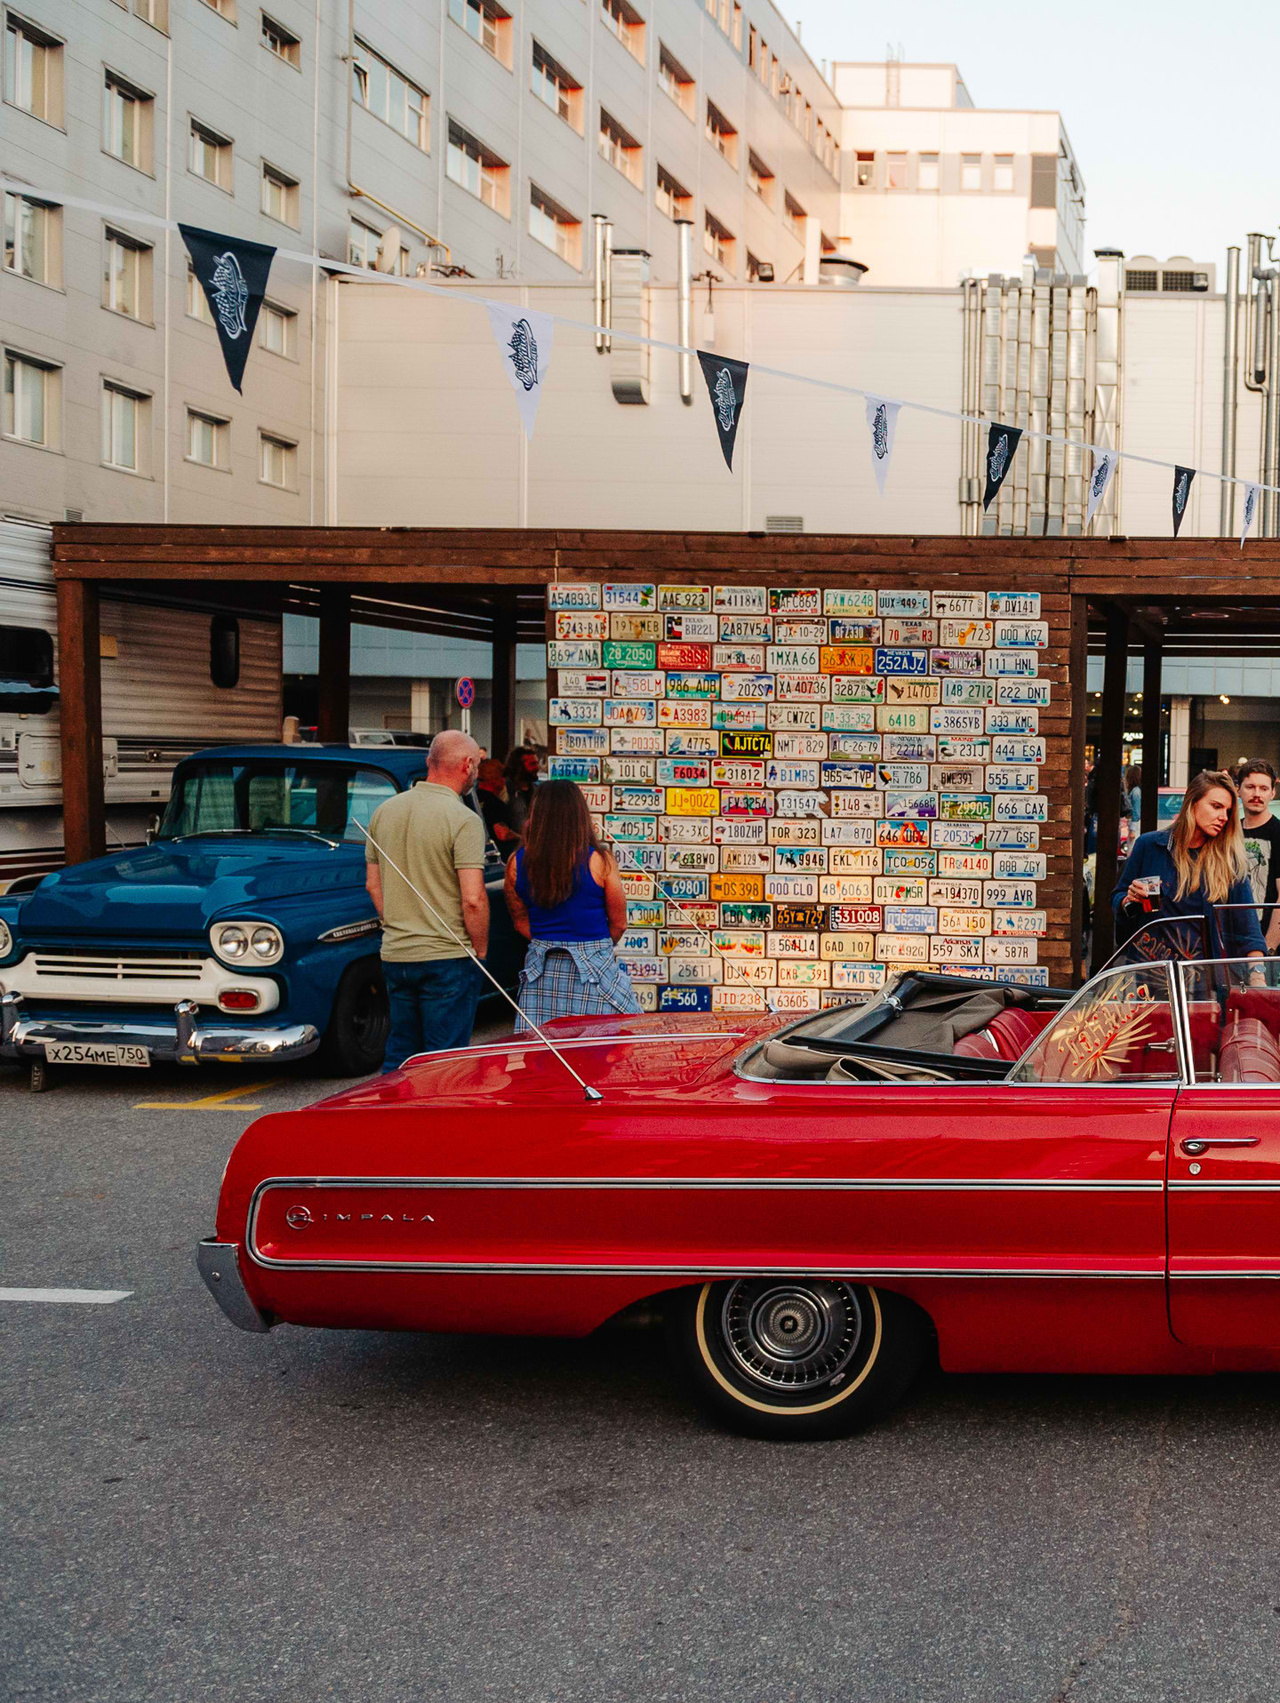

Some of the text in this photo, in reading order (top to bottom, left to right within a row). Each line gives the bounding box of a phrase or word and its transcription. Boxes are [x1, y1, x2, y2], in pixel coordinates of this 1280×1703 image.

[551, 592, 597, 605] A54893C
[605, 592, 639, 603] 31544
[662, 594, 705, 606] AAE 923
[950, 600, 973, 611] 6677
[1005, 601, 1033, 613] DV141
[723, 623, 768, 635] 2A87V54
[972, 628, 990, 641] 723
[889, 630, 933, 641] 70 R3
[1025, 630, 1042, 641] KGZ
[550, 649, 599, 663] 869 ANA
[878, 657, 923, 670] 252AJZ
[1015, 659, 1034, 670] HNL
[669, 679, 689, 692] 986
[780, 681, 826, 694] XA 40736
[835, 684, 859, 696] 3287
[907, 686, 930, 696] 1470
[969, 685, 992, 697] 2712
[1000, 687, 1047, 699] 222 DNT
[573, 707, 591, 718] 333
[635, 708, 653, 720] 793
[674, 709, 707, 720] A3983
[889, 714, 915, 726] 6418
[991, 716, 1032, 727] 333 KMC
[687, 738, 710, 750] 4775
[734, 737, 770, 750] AJTC74
[778, 740, 824, 752] NMT 829
[897, 744, 922, 756] 2270
[996, 745, 1042, 756] 444 ESA
[640, 766, 651, 777] GL
[728, 769, 760, 780] 31812
[824, 771, 842, 782] 965
[904, 772, 922, 784] 786
[988, 774, 1035, 786] 555 EJF
[628, 794, 660, 806] 22938
[781, 798, 816, 809] T31547
[842, 799, 860, 811] 148
[957, 802, 990, 814] 29905
[998, 804, 1044, 815] 666 CAX
[621, 822, 653, 836] 40515
[772, 827, 816, 839] TOR 323
[824, 828, 872, 839] LA7 870
[880, 830, 898, 842] 646
[944, 830, 974, 842] 20535
[990, 831, 1035, 842] 777 GSF
[799, 854, 824, 866] 9946
[834, 856, 878, 866] EKL 116
[963, 858, 988, 870] 4140
[1000, 862, 1040, 872] 888 ZGY
[672, 881, 705, 894] 69801
[740, 883, 758, 895] 398
[823, 884, 869, 895] 48 6063
[946, 888, 978, 900] 194370
[987, 889, 1032, 901] 999 AVR
[805, 911, 823, 924] 729
[836, 911, 880, 922] 531008
[966, 917, 985, 928] 150
[1024, 919, 1042, 930] 297
[825, 941, 869, 952] GAD 107
[933, 945, 979, 957] 559 SKX
[1005, 947, 1028, 958] 587R
[678, 965, 711, 977] 25611
[754, 967, 773, 980] 457
[777, 996, 808, 1007] 63605
[119, 1047, 144, 1060] 750
